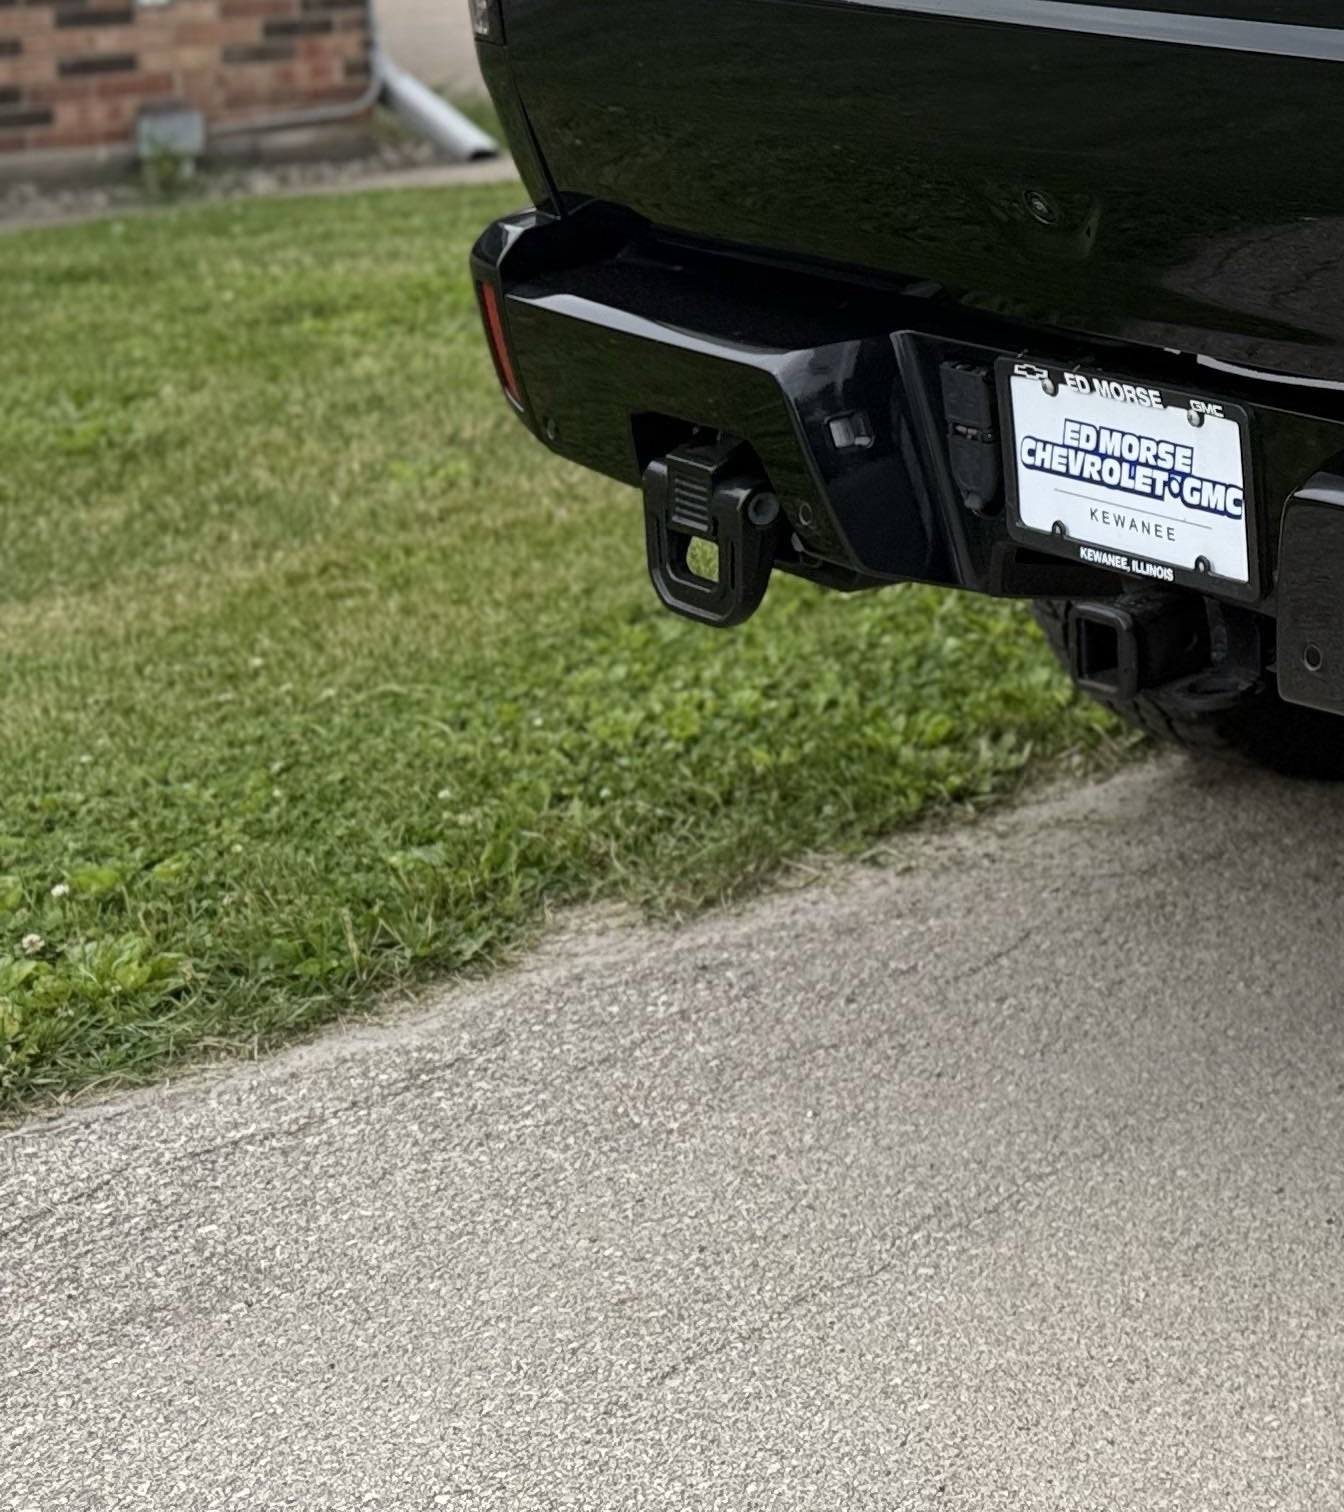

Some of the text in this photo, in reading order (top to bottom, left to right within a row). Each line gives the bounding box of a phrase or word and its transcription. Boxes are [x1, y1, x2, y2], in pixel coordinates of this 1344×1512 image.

[1064, 372, 1163, 408] ED MORSE
[1190, 399, 1224, 418] GMC
[1063, 418, 1194, 474] ED MORSE
[1089, 507, 1177, 541] KEWANEE
[1080, 546, 1174, 582] KEWANEE, ILLINOIS
